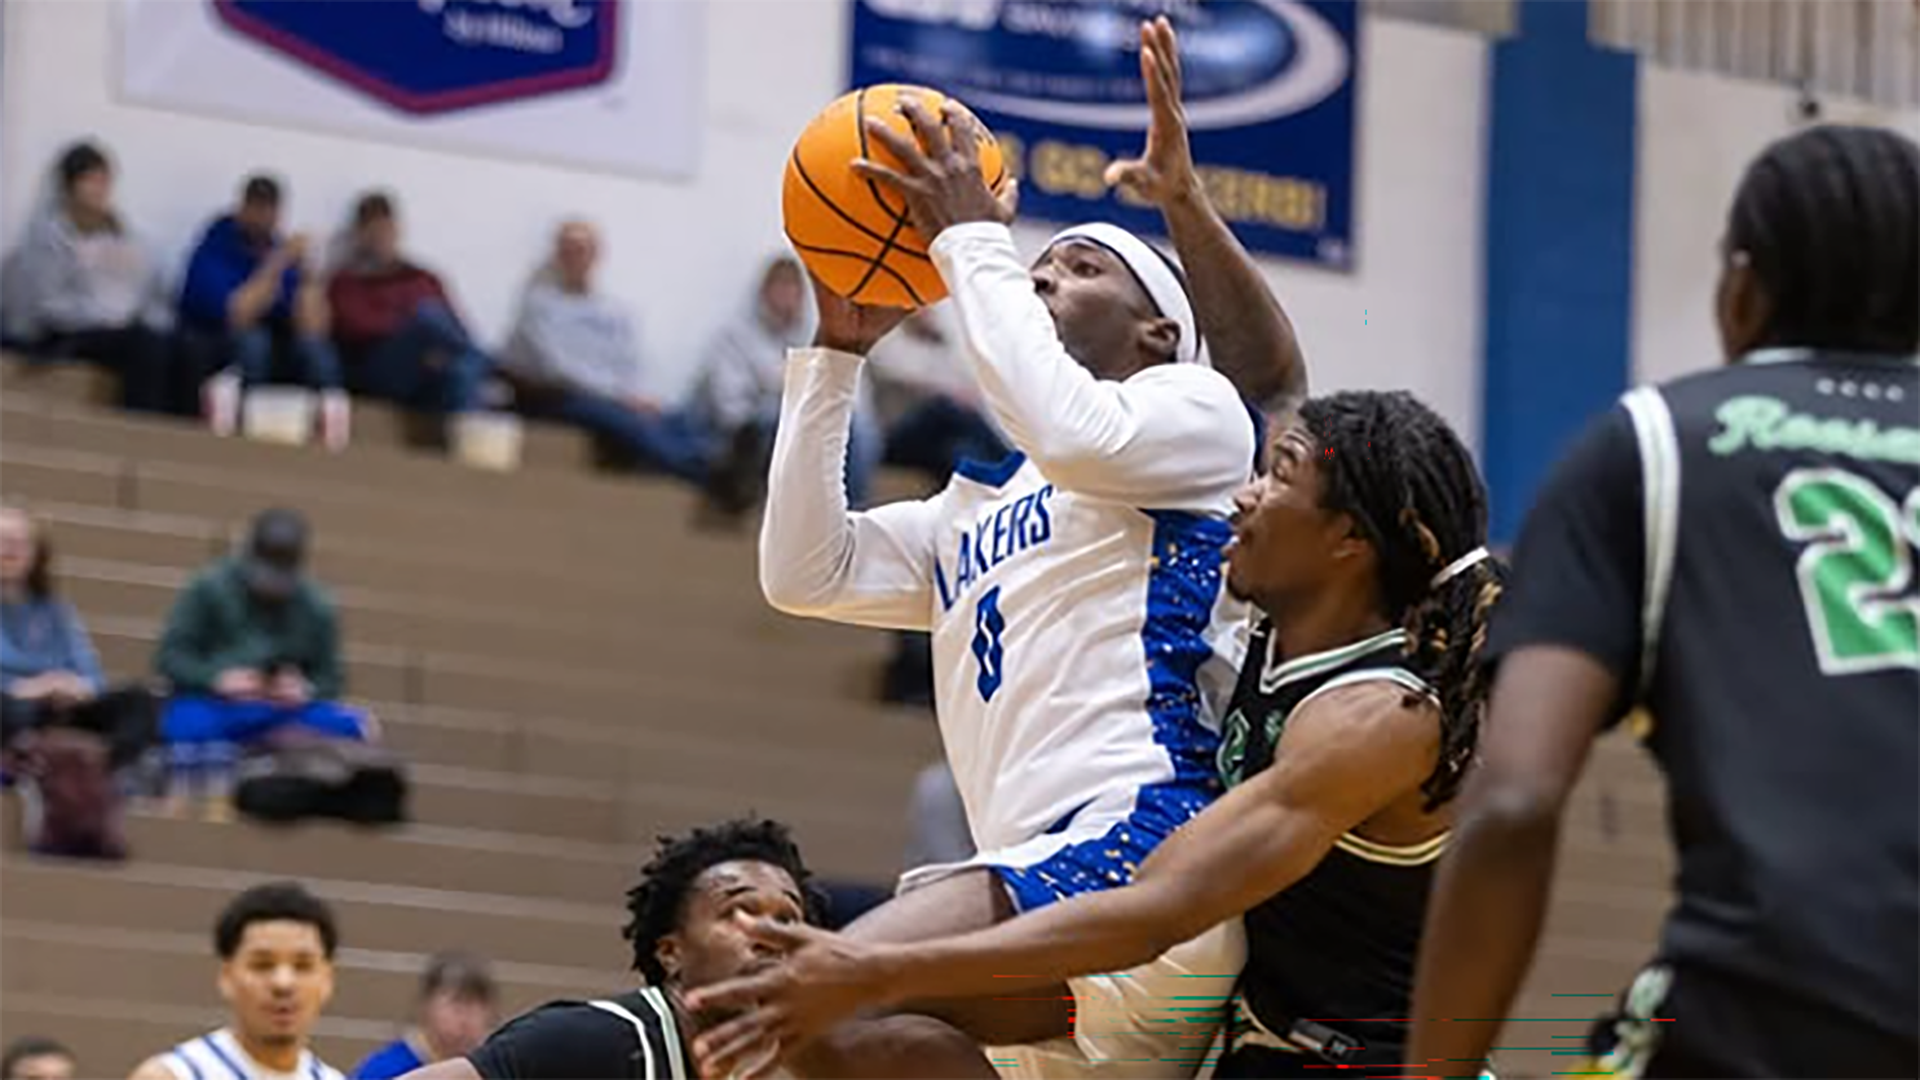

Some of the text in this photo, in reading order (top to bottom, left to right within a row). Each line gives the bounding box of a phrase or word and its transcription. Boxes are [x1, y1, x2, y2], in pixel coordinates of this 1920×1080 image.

[935, 485, 1053, 612] LAKERS
[1773, 466, 1920, 676] 2
[971, 585, 1005, 703] 0
